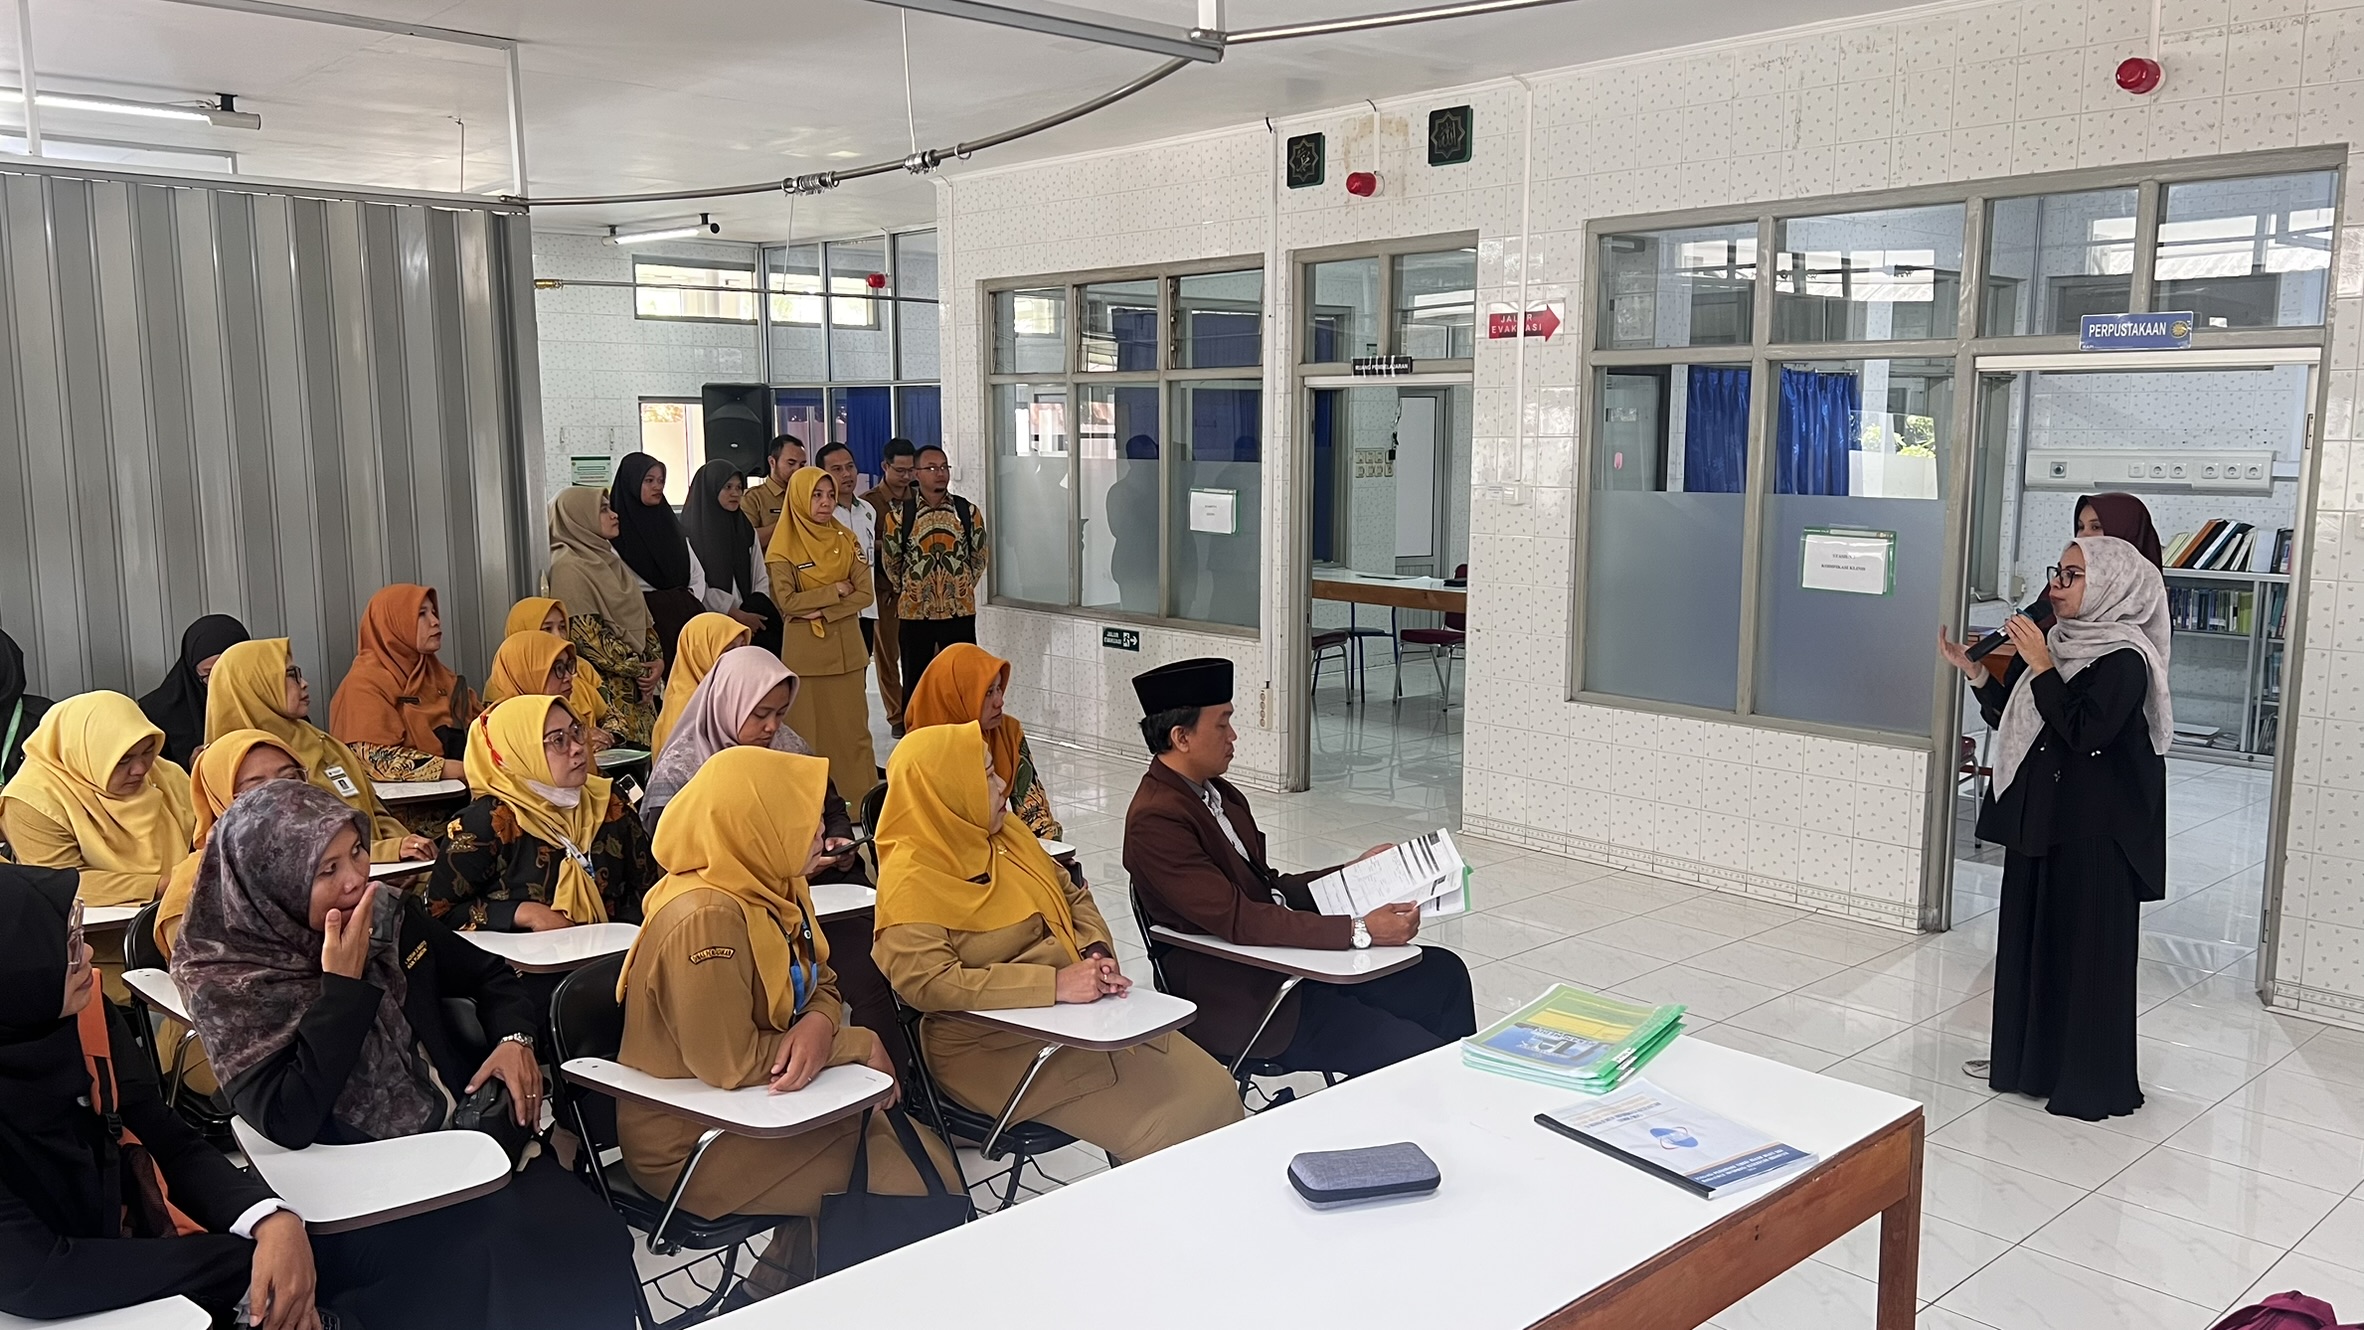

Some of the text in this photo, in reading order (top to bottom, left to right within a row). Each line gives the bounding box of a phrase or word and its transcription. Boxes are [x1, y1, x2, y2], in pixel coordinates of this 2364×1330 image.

[1500, 313, 1533, 323] JALR
[1491, 323, 1542, 334] EVAKASI
[2088, 322, 2167, 338] PERPUSTAKAAN
